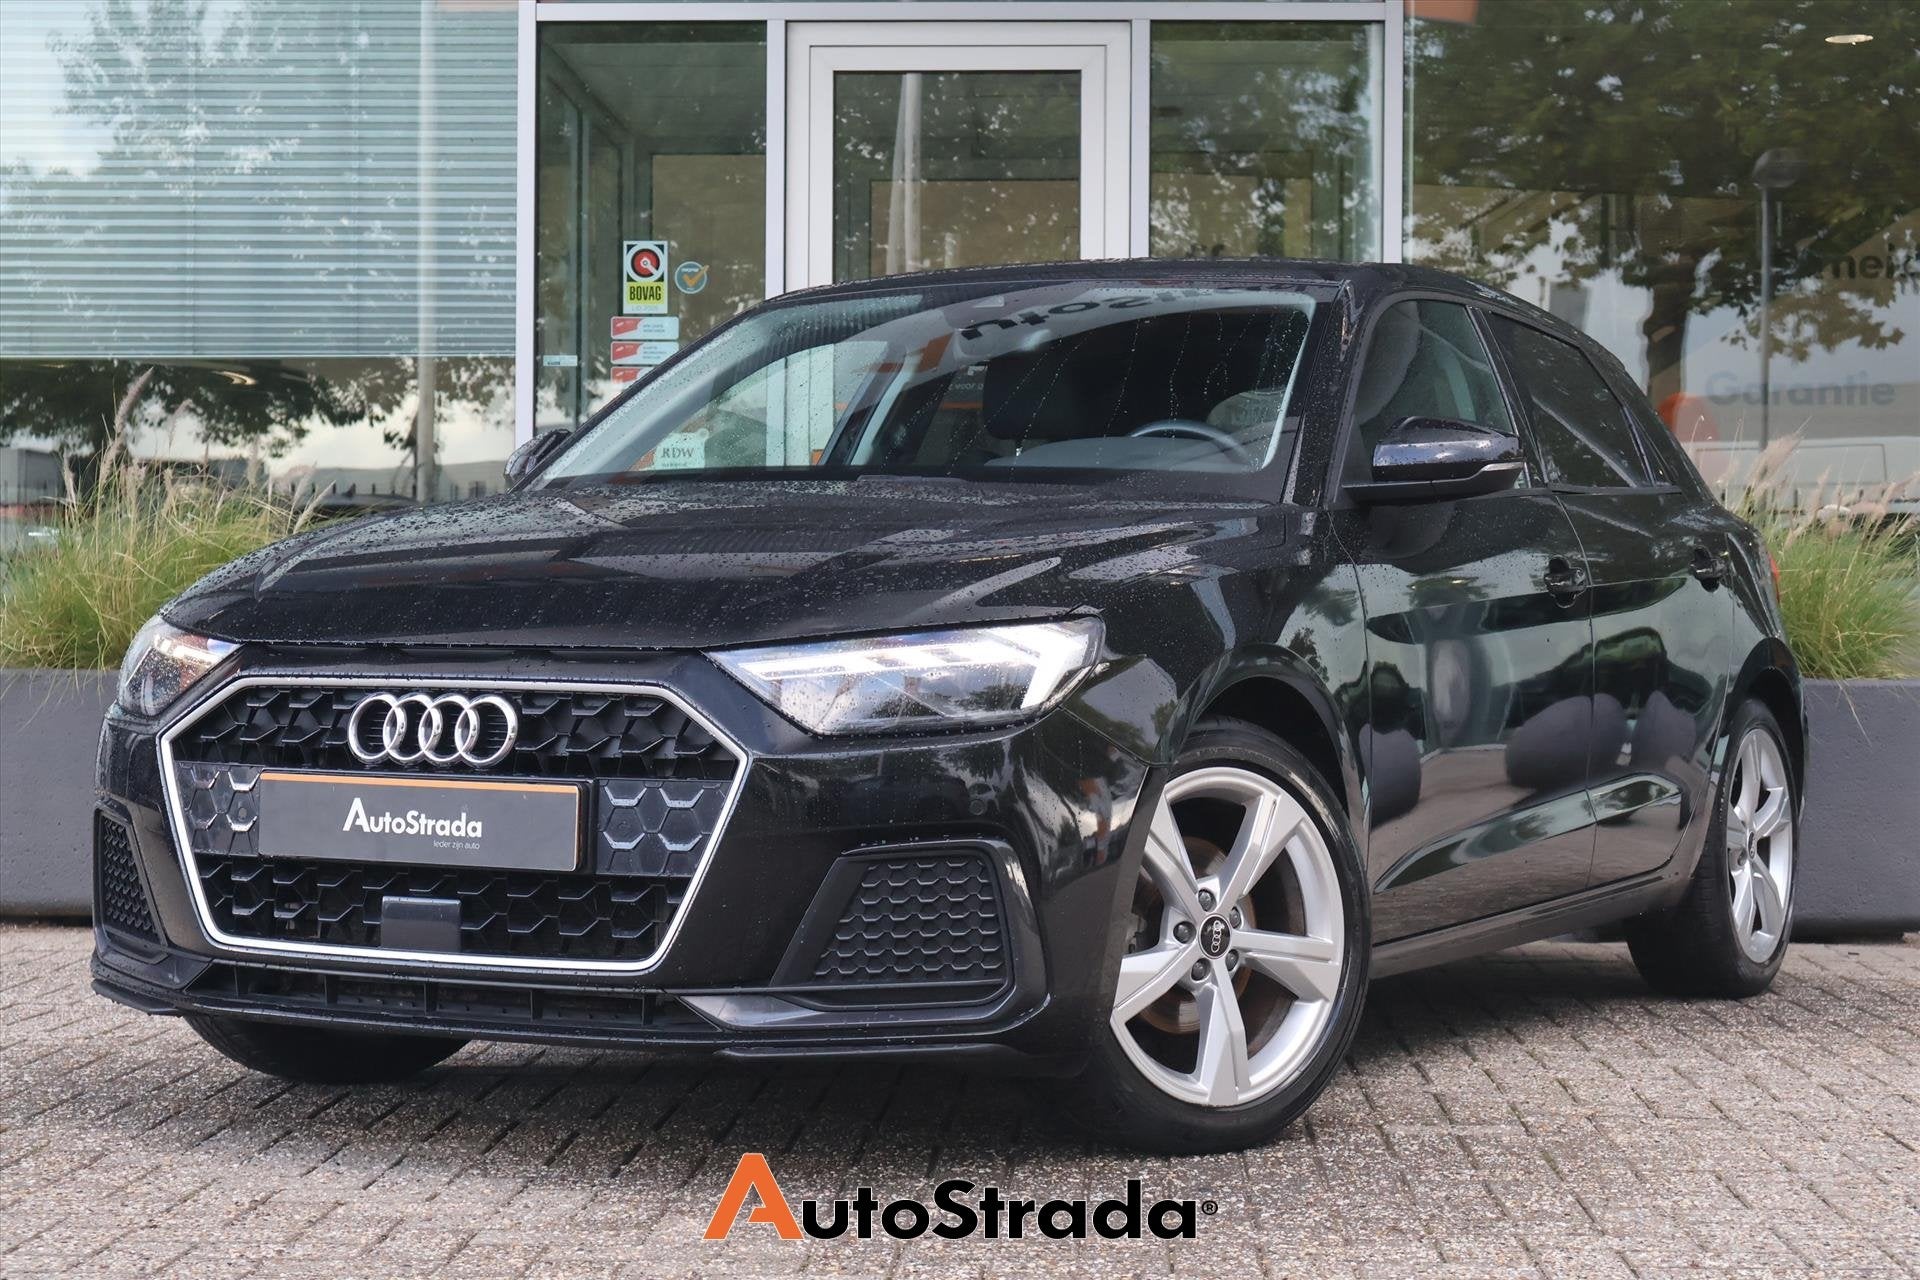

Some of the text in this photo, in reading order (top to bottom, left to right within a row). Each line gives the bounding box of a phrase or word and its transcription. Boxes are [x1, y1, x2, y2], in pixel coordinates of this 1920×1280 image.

[629, 285, 662, 301] BOVAG
[1705, 369, 1897, 405] Garantie
[661, 447, 694, 458] RDW
[342, 797, 482, 838] AutoStrada
[452, 840, 464, 850] zijn
[464, 842, 480, 850] auto
